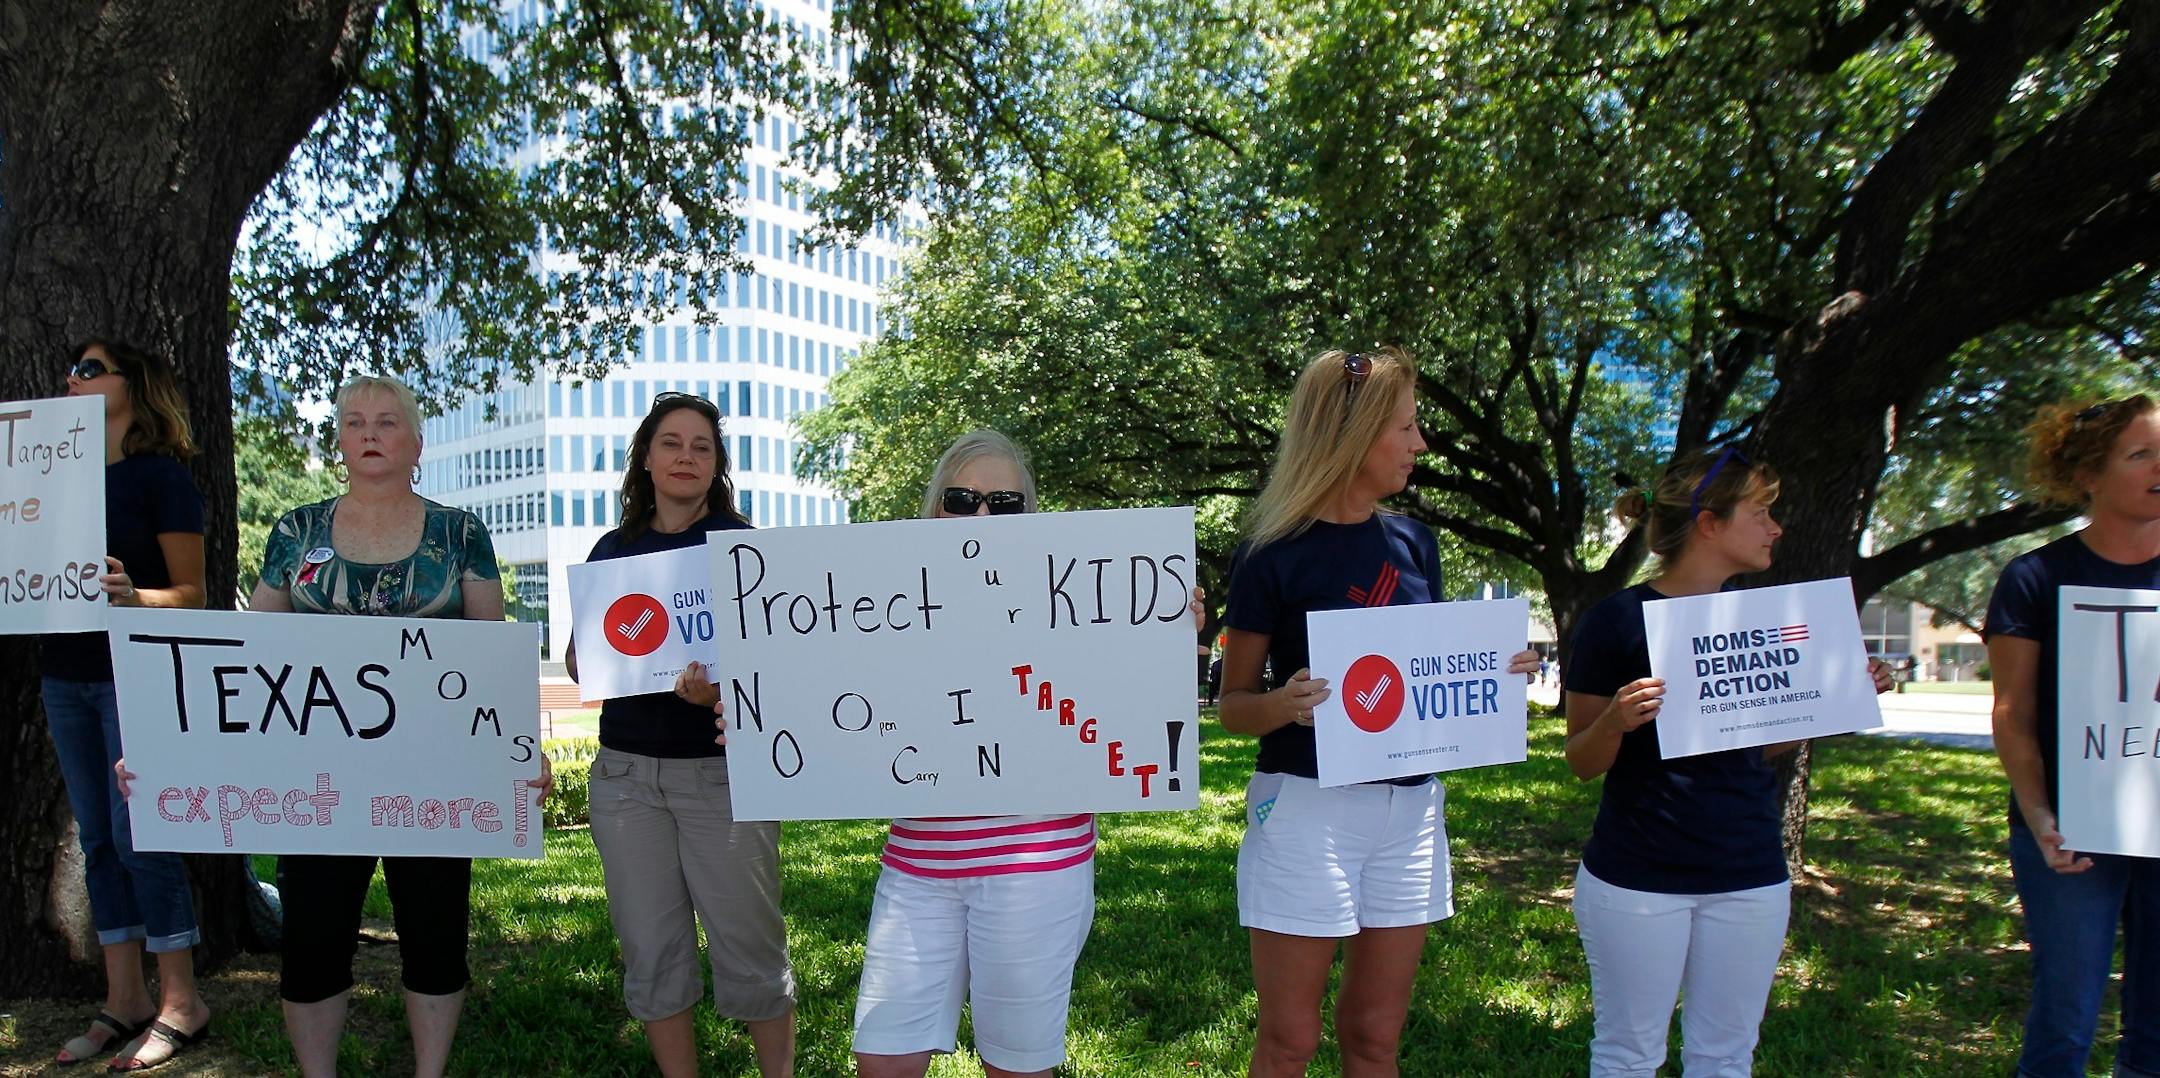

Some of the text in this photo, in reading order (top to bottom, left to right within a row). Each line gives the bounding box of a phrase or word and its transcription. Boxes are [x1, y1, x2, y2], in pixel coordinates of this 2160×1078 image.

[0, 410, 86, 475] Target
[673, 589, 705, 609] GUN
[729, 543, 942, 639] Protect
[1048, 554, 1187, 629] KIDS
[1692, 629, 1766, 655] MOMS
[2073, 603, 2160, 702] T
[1411, 652, 1497, 677] GUN SENSE
[1695, 647, 1800, 677] DEMAND
[129, 628, 535, 763] TEXAS MOMS
[1412, 679, 1498, 720] VOTER
[1699, 671, 1790, 700] ACTION
[1701, 690, 1822, 714] FOR GUN SENSE IN AMERICA
[732, 672, 803, 778] NO
[832, 692, 896, 737] Open
[892, 746, 939, 786] Carry
[948, 689, 1000, 777] IN
[1387, 745, 1460, 759] www.gunsensevoter.org
[157, 773, 529, 848] expect more!
